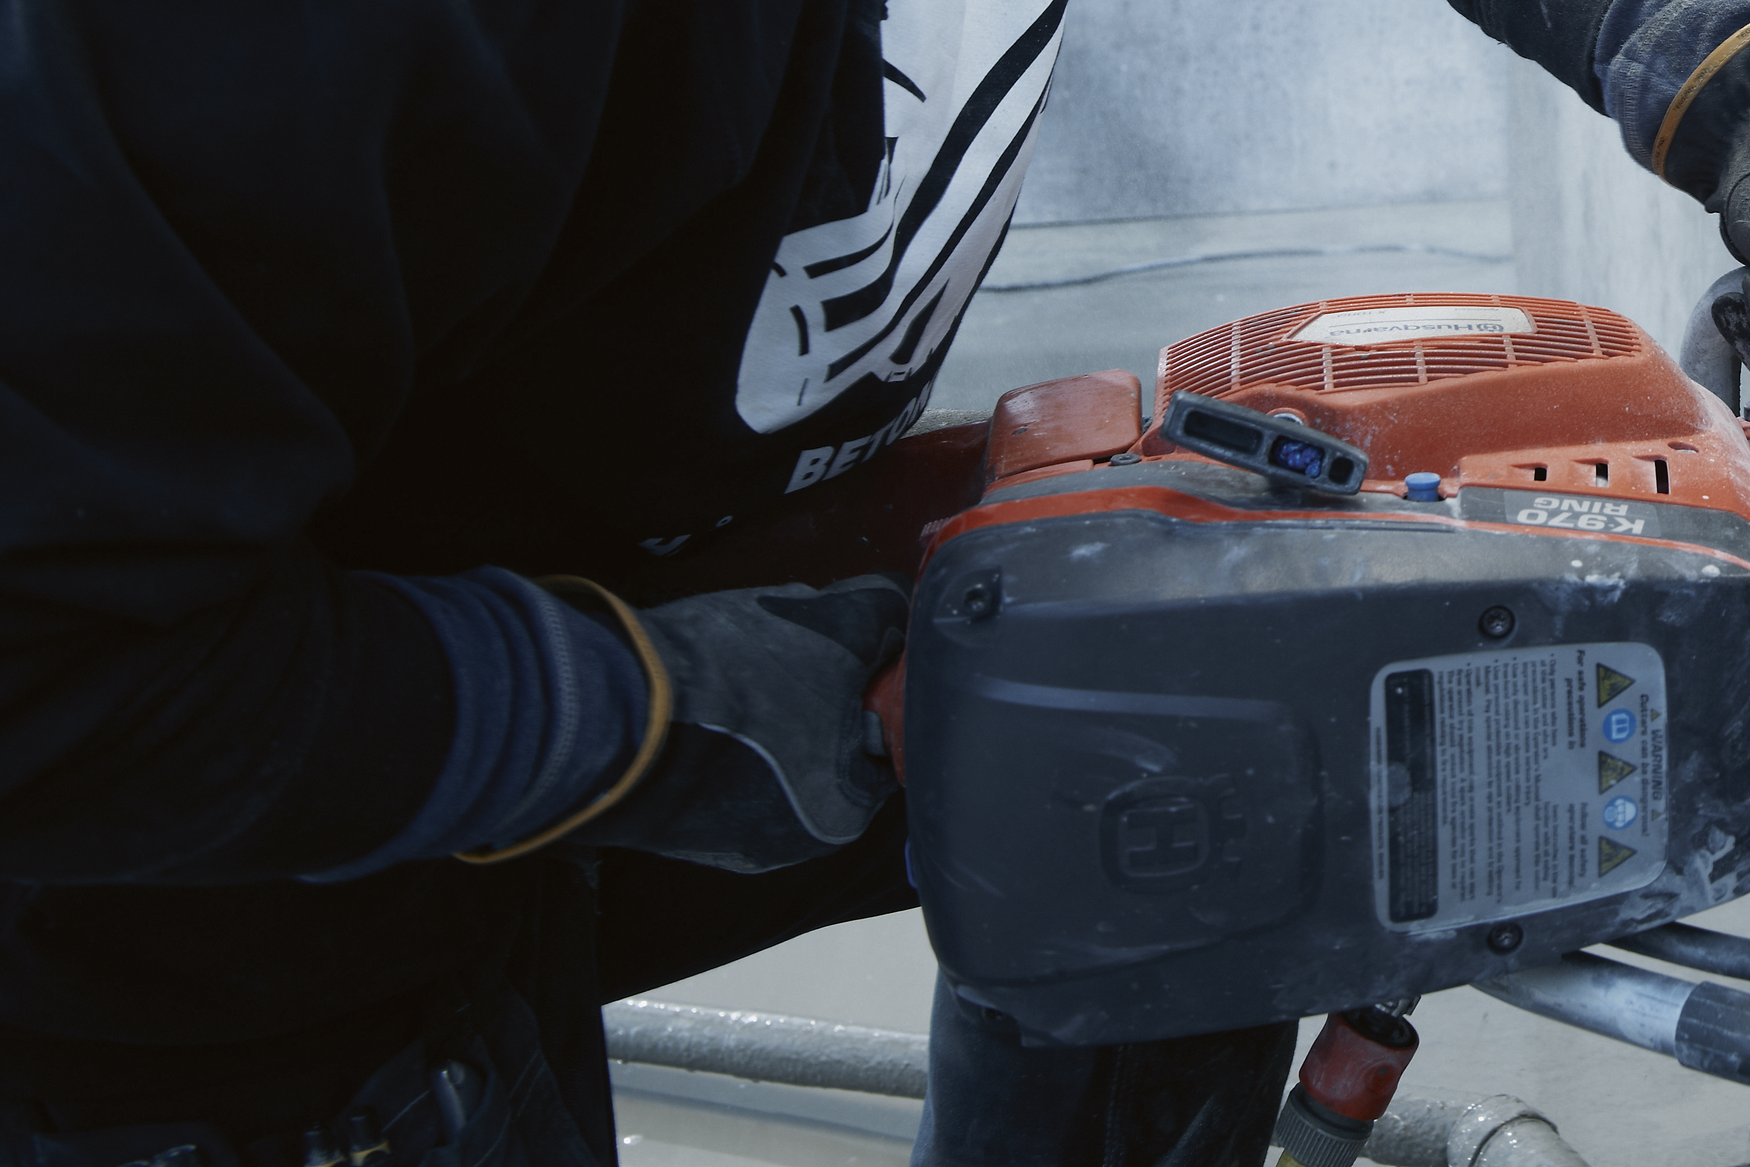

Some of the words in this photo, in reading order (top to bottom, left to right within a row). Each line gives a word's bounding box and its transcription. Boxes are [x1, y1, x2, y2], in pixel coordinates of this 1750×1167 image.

[1330, 323, 1473, 337] Husqvarna
[1533, 497, 1629, 516] RING
[1641, 694, 1649, 735] Cutters
[1642, 763, 1650, 775] be
[1652, 729, 1663, 800] WARNING
[1640, 779, 1650, 836] dangerous!
